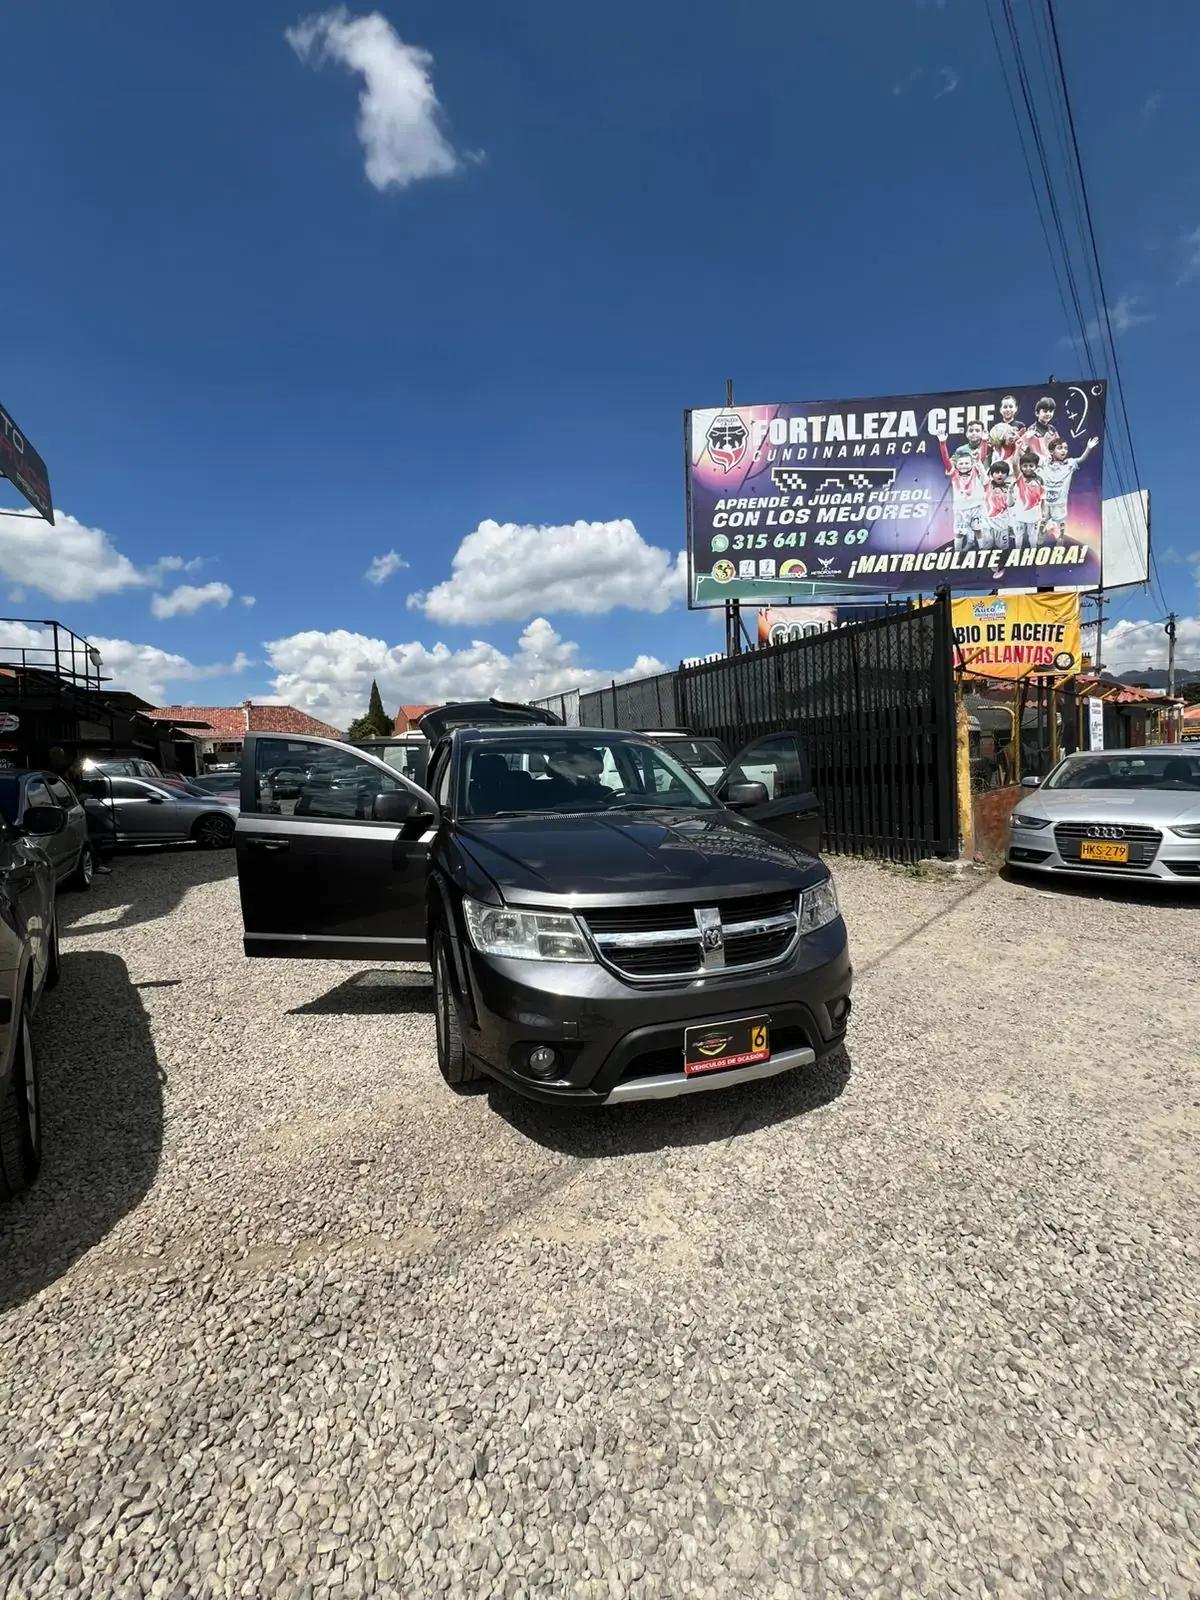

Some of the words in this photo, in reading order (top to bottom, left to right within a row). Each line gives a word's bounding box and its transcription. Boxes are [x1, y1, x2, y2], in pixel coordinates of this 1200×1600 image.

[752, 412, 918, 445] FORTALEZA
[927, 404, 996, 435] CEIF
[752, 441, 926, 462] CUNDINAMARCA
[714, 496, 790, 510] APRENDE
[792, 495, 804, 507] A
[808, 492, 865, 506] JUGAR
[868, 487, 932, 503] FÚTBOL
[712, 511, 761, 528] CON
[766, 509, 811, 525] LOS
[816, 503, 929, 523] MEJORES
[732, 534, 768, 550] 315
[773, 532, 807, 548] 641
[814, 530, 839, 546] 43
[843, 528, 869, 545] 69
[847, 547, 1003, 579] ¡MATRICÚLATE
[1004, 544, 1089, 567] AHORA!
[986, 624, 1005, 642] DE
[1011, 623, 1064, 642] ACEITE
[754, 1025, 765, 1047] 6
[727, 1057, 737, 1065] DE
